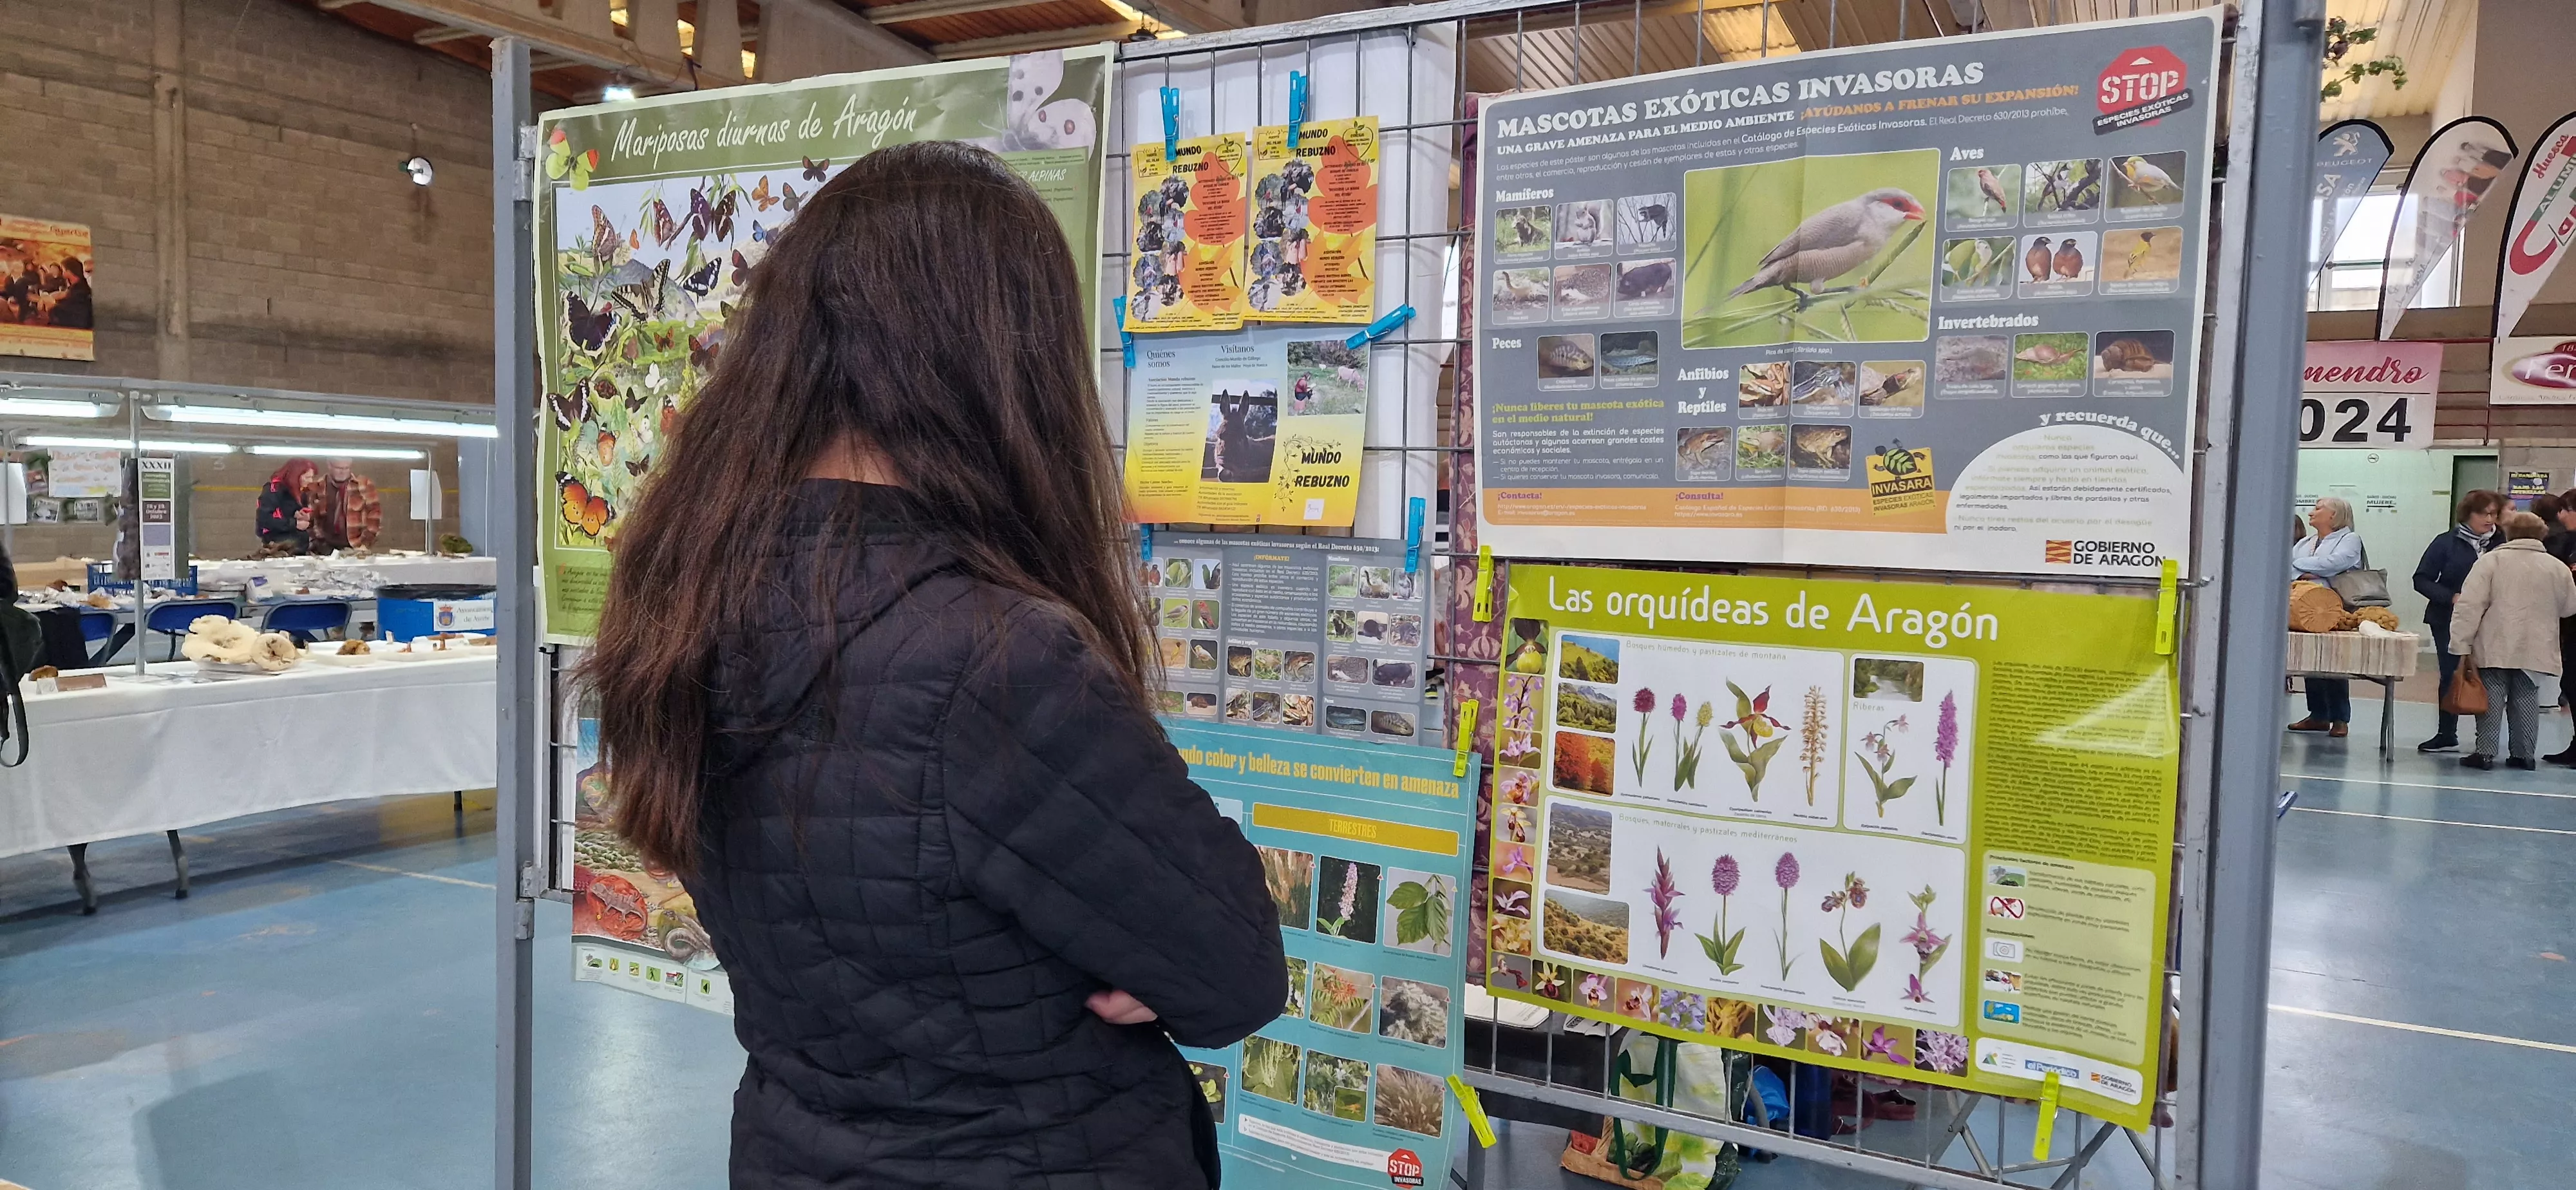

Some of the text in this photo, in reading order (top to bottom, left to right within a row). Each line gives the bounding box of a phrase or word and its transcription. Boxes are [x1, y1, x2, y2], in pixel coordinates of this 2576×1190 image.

[2101, 70, 2179, 104] STOP
[1498, 62, 1984, 138] MASCOTAS EXÓTICAS INVASORAS
[1801, 84, 2079, 120] ¡AYÚDANOS A FRENAR SU EXPANSIÓN!
[2097, 93, 2189, 126] ESPECIES EXÓTICAS
[2117, 106, 2172, 127] INVASORAS
[611, 93, 919, 169] Mariposas diurnas de Aragón
[1297, 128, 1328, 140] MUNDO
[1497, 110, 1794, 155] UNA GRAVE AMENAZA PARA EL MEDIO AMBIENTE
[1510, 161, 1538, 171] especies
[1565, 156, 1587, 166] póster
[1602, 151, 1629, 161] algunas
[1652, 144, 1686, 154] mascotas
[1687, 140, 1721, 149] incluidas
[1742, 132, 1782, 144] Catálogo
[1784, 129, 1794, 138] de
[1796, 125, 1834, 137] Especies
[1838, 122, 1877, 133] Exóticas
[1879, 118, 1927, 129] Invasoras.
[1929, 117, 1937, 126] El
[1937, 116, 1957, 125] Real
[1958, 113, 1991, 124] Decreto
[1994, 109, 2029, 120] 630/2013
[2031, 107, 2068, 119] prohíbe,
[1174, 146, 1201, 158] MUNDO
[1294, 146, 1336, 158] REBUZNO
[1950, 147, 1984, 161] Aves
[2532, 134, 2569, 180] Huesca
[1173, 161, 1208, 174] REBUZNO
[2316, 158, 2372, 167] PEUGEOT
[1028, 168, 1067, 182] ALPINAS
[1496, 188, 1553, 202] Mamíferos
[1938, 313, 2039, 330] Invertebrados
[1221, 344, 1254, 354] Visítanos
[1492, 337, 1521, 349] Peces
[1147, 349, 1175, 359] Quiénes
[1678, 367, 1728, 381] Anfibios
[1699, 387, 1707, 399] y
[1580, 401, 1624, 410] mascota
[1626, 400, 1664, 408] exótica
[1678, 401, 1726, 416] Reptiles
[1519, 415, 1549, 423] medio
[1552, 413, 1593, 422] natural!
[1511, 429, 1557, 439] responsables
[1583, 428, 1615, 436] extinción
[1633, 427, 1664, 436] especies
[2040, 411, 2180, 460] y recuerda que...
[1542, 438, 1569, 448] algunas
[1607, 437, 1637, 446] grandes
[1302, 450, 1341, 464] MUNDO
[1294, 475, 1349, 487] REBUZNO
[1871, 477, 1932, 495] INVASARA
[1498, 491, 1542, 500] ¡Contacta!
[1676, 492, 1723, 502] ¡Consulta!
[1873, 492, 1934, 505] ESPECIES EXÓTICAS
[1873, 502, 1908, 511] INVASORAS
[2074, 540, 2155, 554] GOBIERNO
[2074, 553, 2093, 565] DE
[1549, 575, 1997, 648] Las orquídeas de Aragón
[1626, 639, 1654, 652] Bosques
[1658, 643, 1689, 654] húmedos
[1700, 648, 1736, 657] pastizales
[1853, 701, 1884, 712] Riberas
[1206, 748, 1238, 768] color
[1239, 757, 1246, 775] y
[1249, 753, 1291, 777] belleza
[1293, 762, 1308, 779] se
[1310, 765, 1380, 788] convierten
[1383, 773, 1398, 789] en
[1401, 775, 1459, 799] amenaza
[1329, 818, 1376, 838] TERRESTRES
[1654, 820, 1690, 831] matorrales
[1700, 827, 1737, 837] pastizales
[1741, 830, 1797, 843] mediterráneos
[1389, 1159, 1420, 1176] STOP
